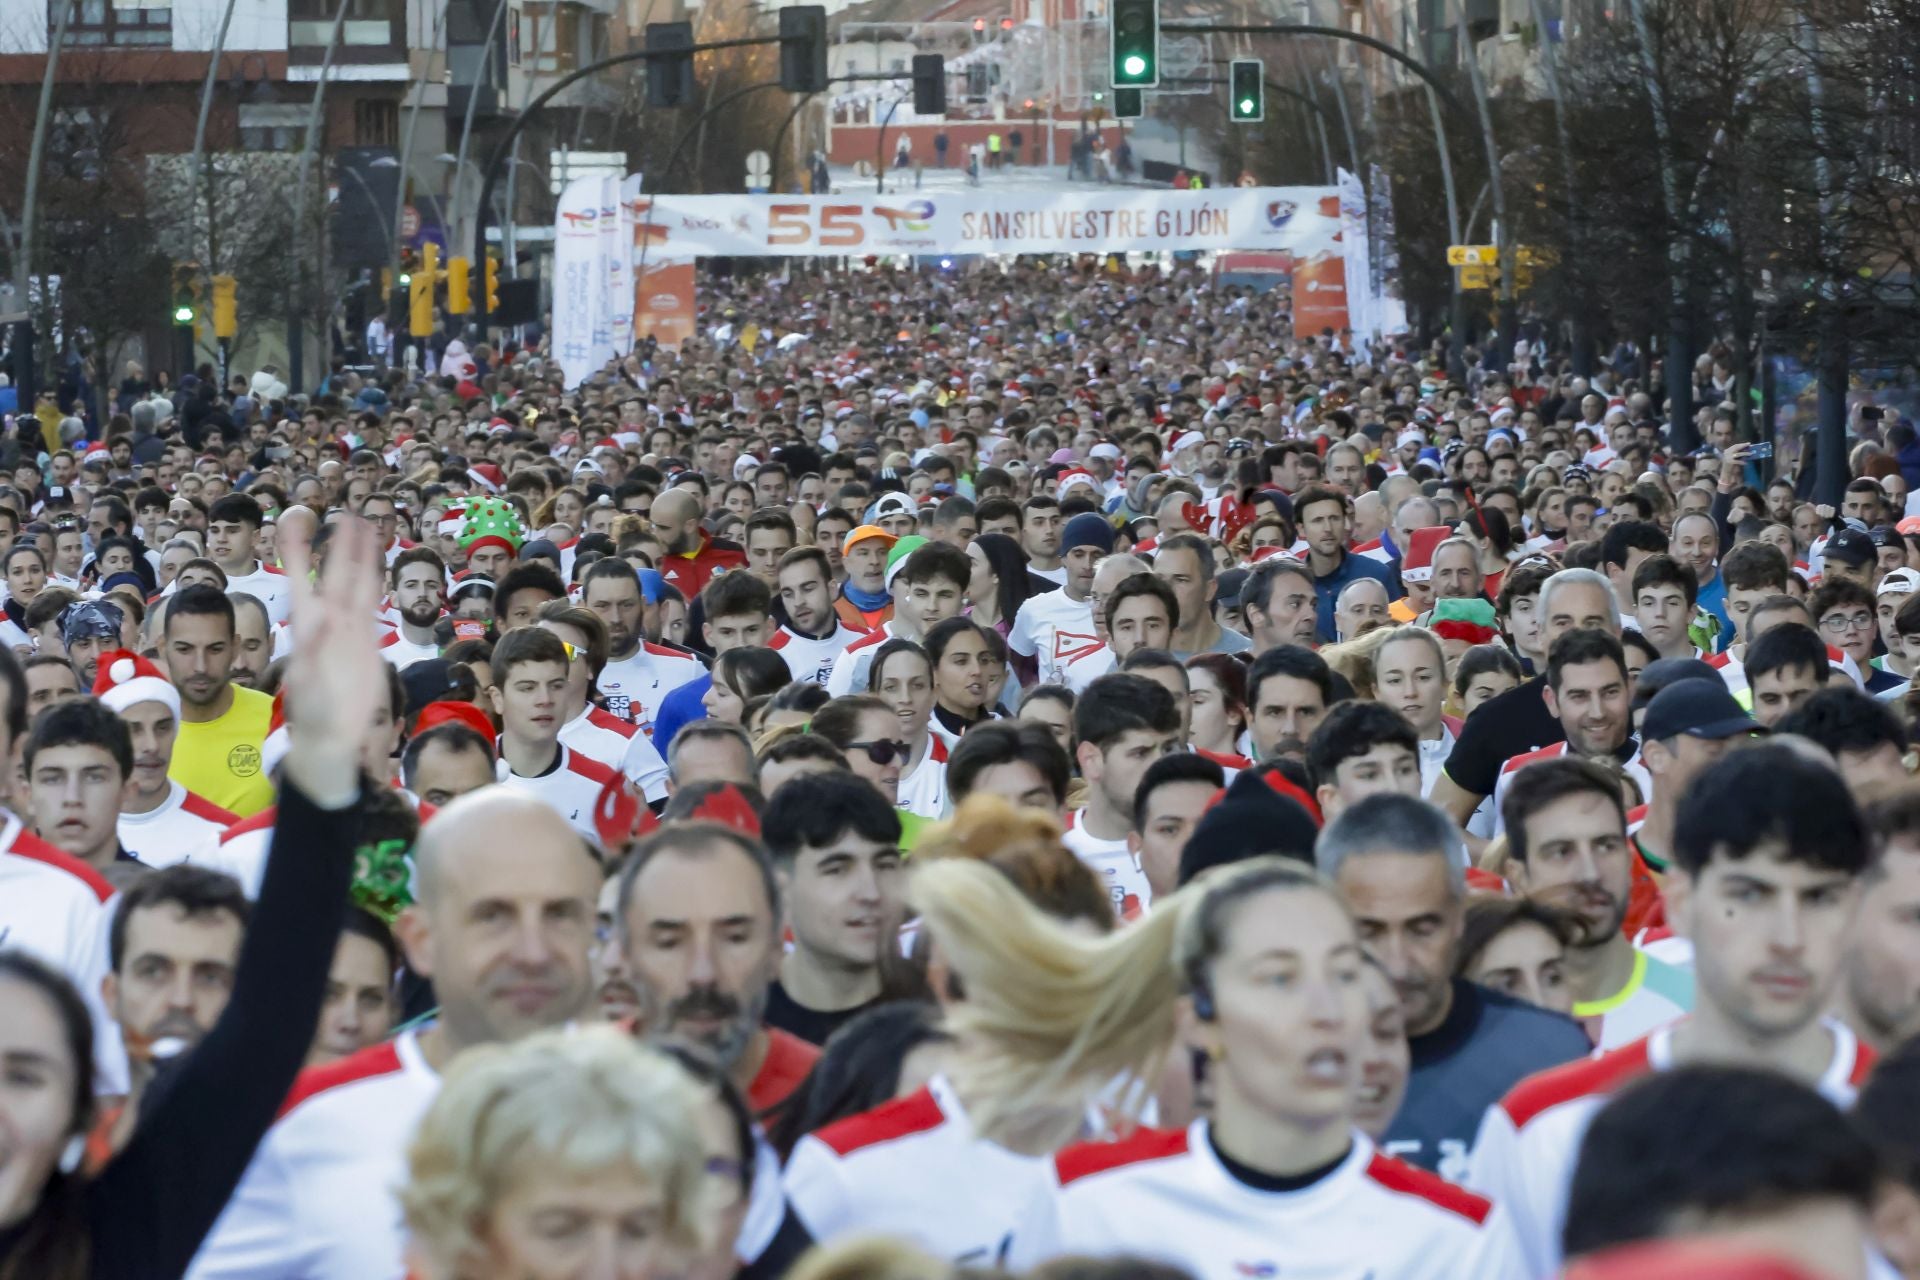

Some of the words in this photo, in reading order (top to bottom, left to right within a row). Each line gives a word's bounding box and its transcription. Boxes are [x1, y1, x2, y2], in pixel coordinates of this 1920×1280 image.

[767, 203, 865, 246] 55
[1155, 202, 1229, 238] GIJÓN
[608, 697, 630, 709] 55
